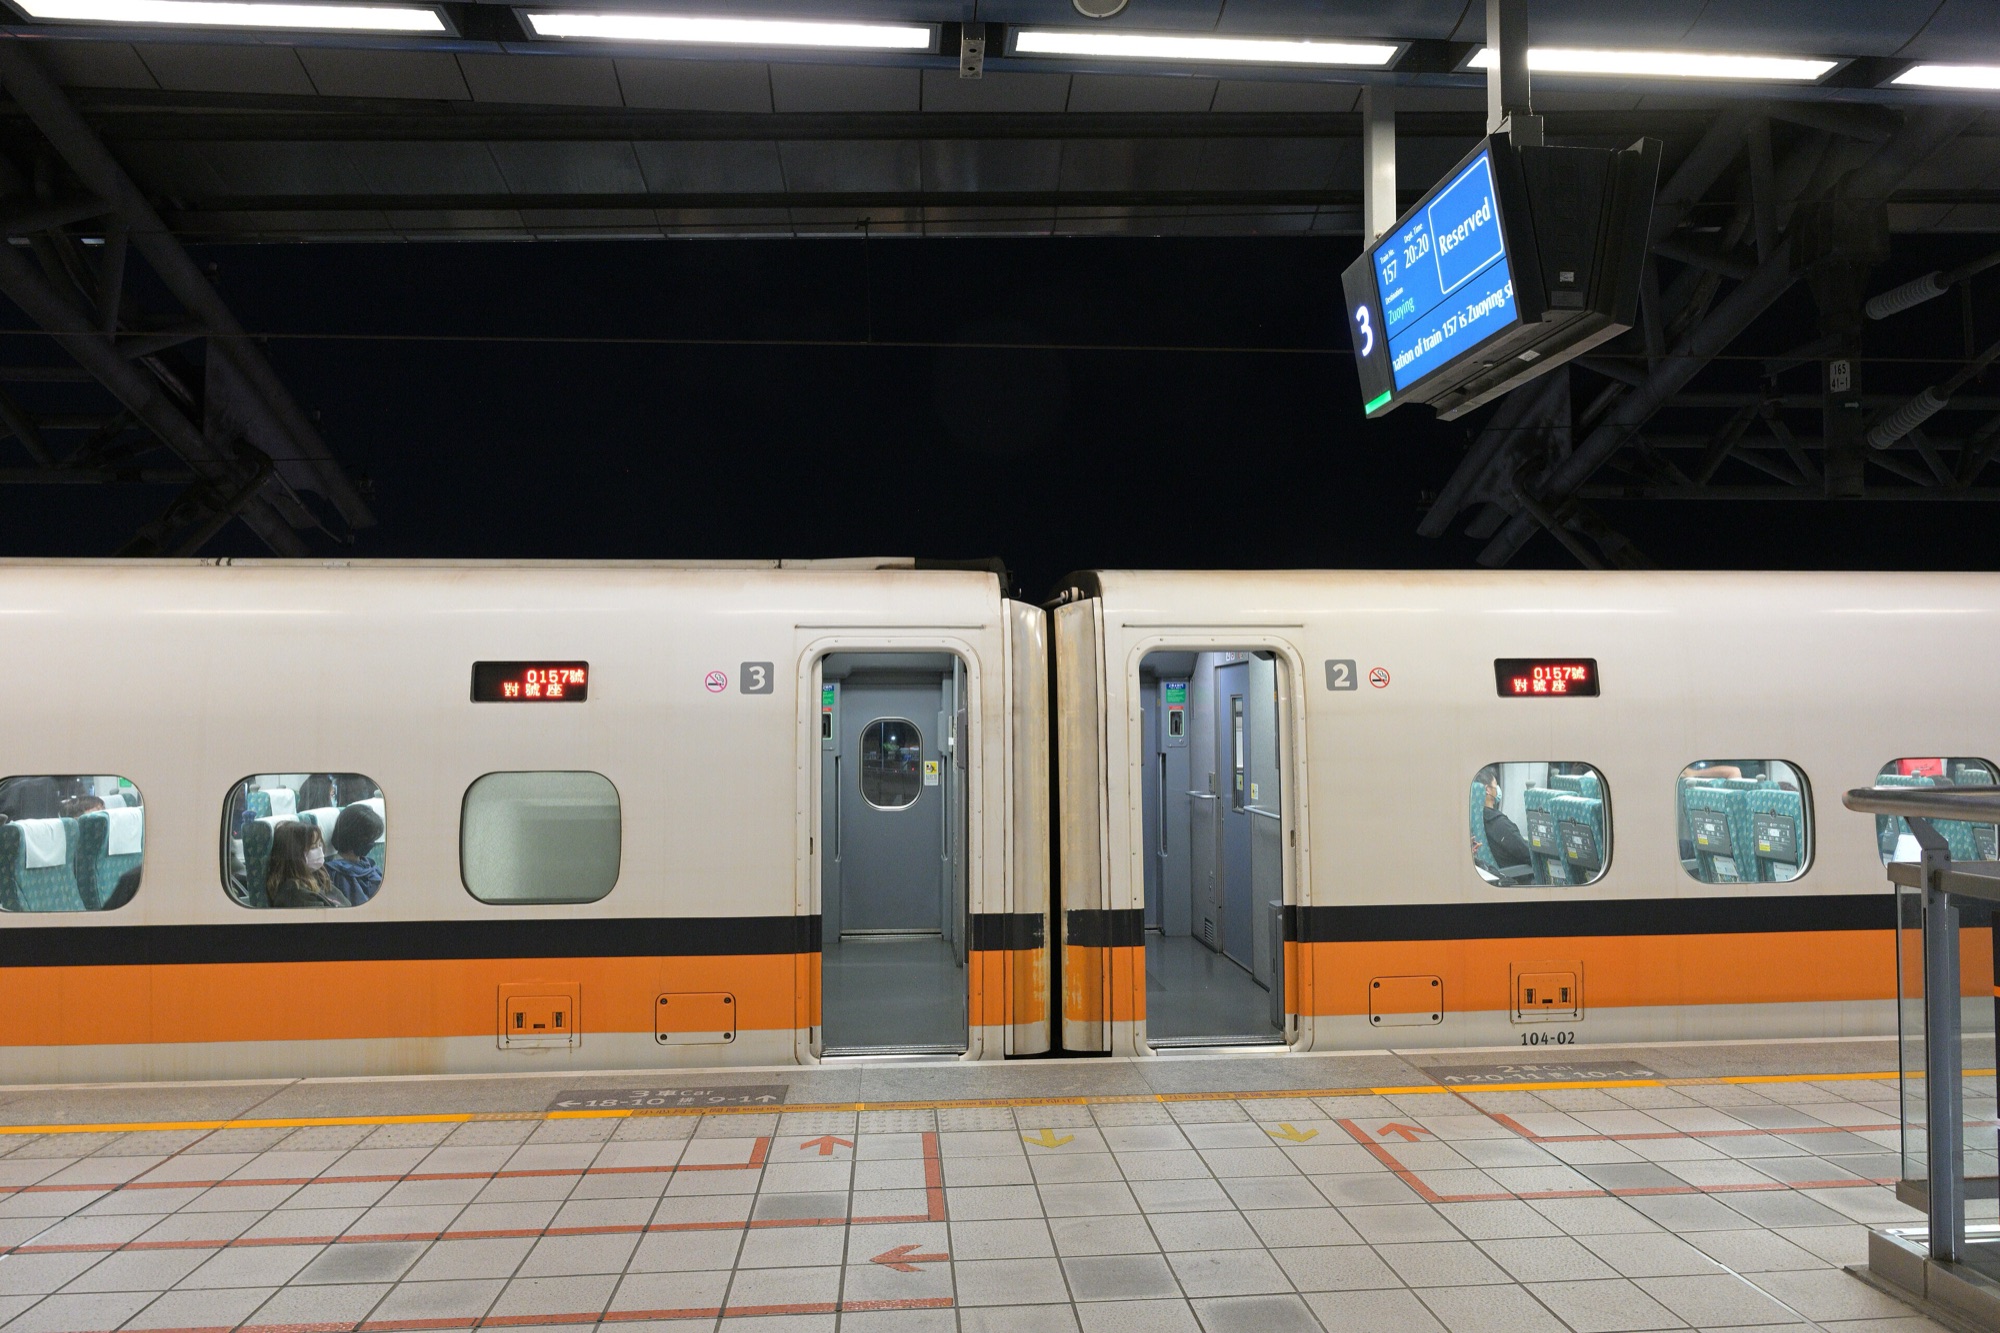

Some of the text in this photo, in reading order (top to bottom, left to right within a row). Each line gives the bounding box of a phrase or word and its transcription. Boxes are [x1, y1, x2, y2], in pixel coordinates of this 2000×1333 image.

[1413, 223, 1423, 235] Time
[1439, 196, 1491, 257] Reserved
[1403, 233, 1429, 269] 20:20
[1382, 259, 1397, 286] 157
[1385, 287, 1404, 305] Destination
[1388, 297, 1415, 326] Zuoying
[1355, 305, 1374, 357] 3
[1414, 337, 1423, 358] of
[1422, 328, 1443, 352] train
[1442, 315, 1457, 339] 157
[1457, 310, 1468, 329] is
[1466, 288, 1505, 324] Zuoying
[1833, 363, 1847, 375] 165
[527, 668, 585, 684] 0157號
[748, 665, 766, 691] 3
[1332, 663, 1350, 687] 2
[1533, 666, 1586, 680] 0157號
[1521, 1031, 1575, 1046] 104-02
[1466, 1073, 1545, 1082] 20-11
[1573, 1070, 1634, 1078] 10-1
[585, 1098, 665, 1107] 18-10
[706, 1095, 751, 1104] 9-1
